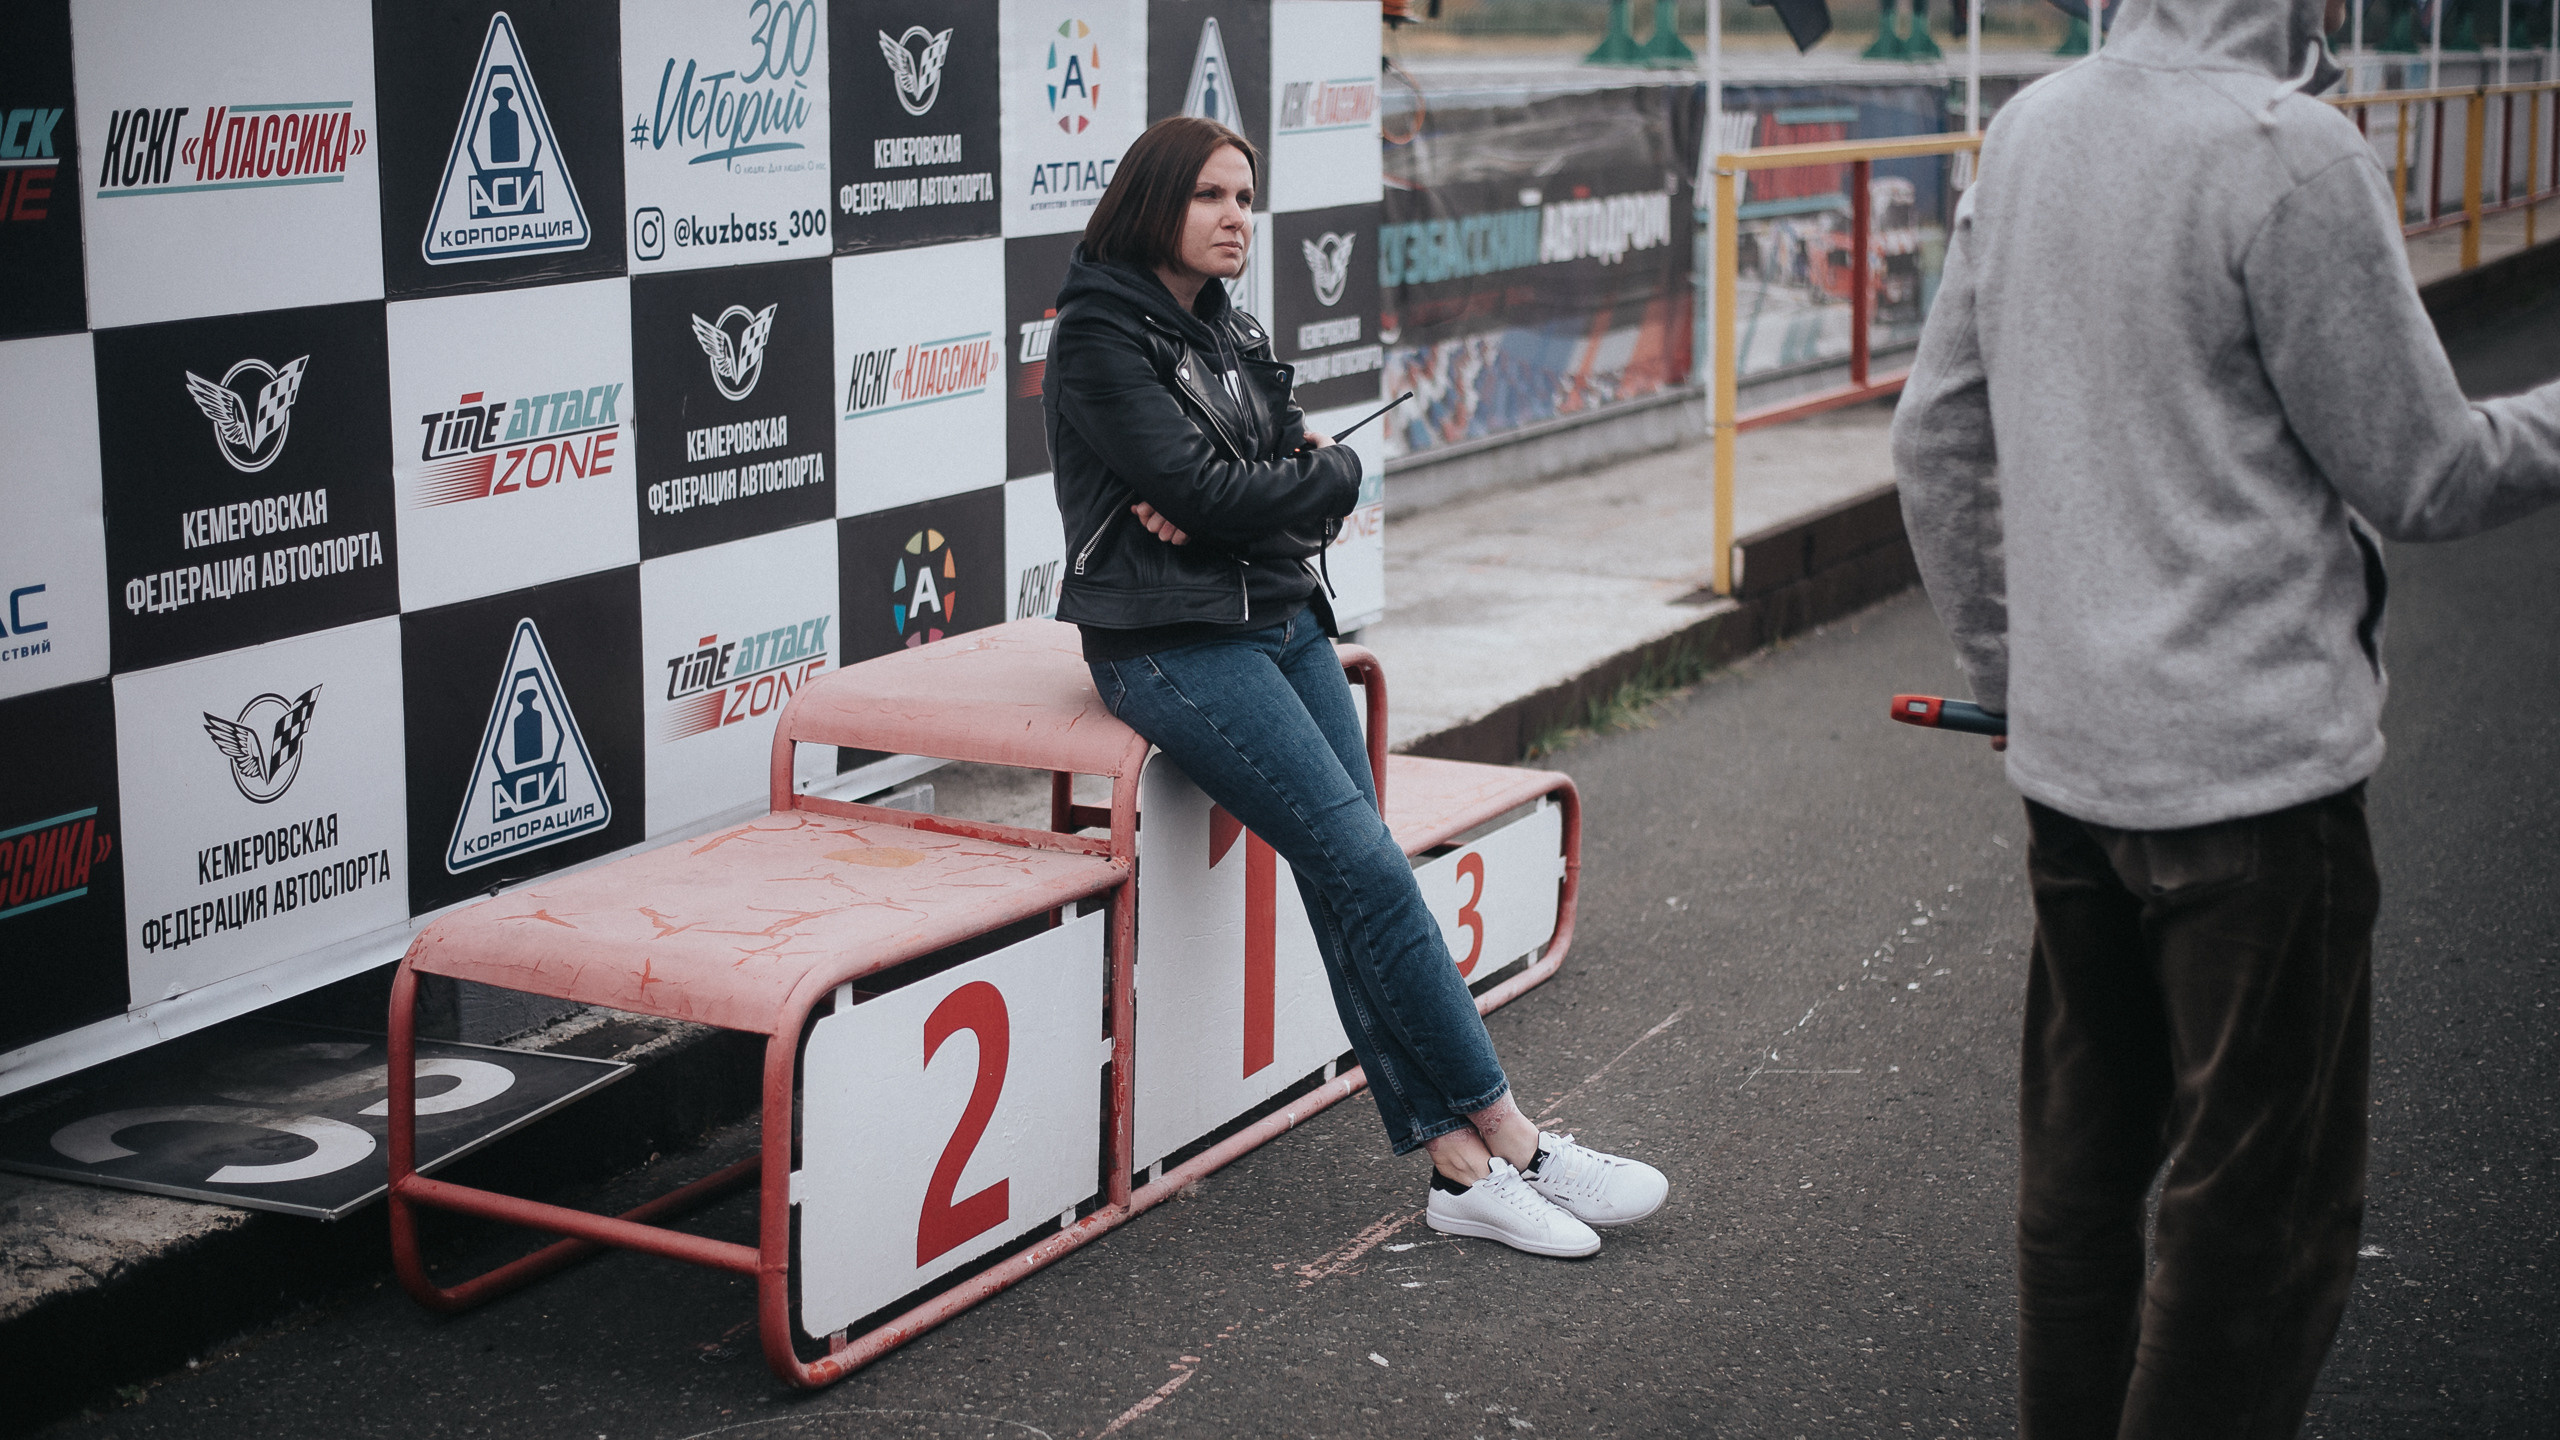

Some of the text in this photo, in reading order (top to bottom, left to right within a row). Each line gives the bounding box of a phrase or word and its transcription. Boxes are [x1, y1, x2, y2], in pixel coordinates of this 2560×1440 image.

[739, 0, 817, 84] 300
[0, 107, 65, 158] CK
[100, 106, 190, 189] КСКГ
[874, 134, 962, 169] КЕМЕРОВСКАЯ
[469, 172, 544, 214] АСИ
[839, 172, 994, 216] ФЕДЕРАЦИЯ АВТОСПОРТА
[1030, 159, 1116, 196] АТЛАС
[440, 219, 574, 248] КОРПОРАЦИЯ
[673, 208, 827, 248] @kuzbass_300
[846, 347, 898, 412] КСКГ
[504, 382, 624, 441] ATTACK
[686, 415, 788, 463] КЕМЕРОВСКАЯ
[492, 431, 619, 496] ZONE
[648, 452, 825, 516] ФЕДЕРАЦИЯ АВТОСПОРТА
[182, 488, 328, 551] КЕМЕРОВСКАЯ
[125, 531, 383, 616] ФЕДЕРАЦИЯ АВТОСПОРТА
[1016, 559, 1060, 620] КСКГ
[0, 583, 49, 638] С
[733, 615, 832, 677] ATTACK
[492, 763, 568, 823] АСИ
[198, 812, 340, 886] КЕМЕРОВСКАЯ
[463, 801, 597, 857] КОРПОРАЦИЯ
[141, 849, 391, 954] ФЕДЕРАЦИЯ АВТОСПОРТА
[1456, 851, 1485, 979] 3
[1209, 802, 1277, 1080] 1
[916, 980, 1011, 1269] 2
